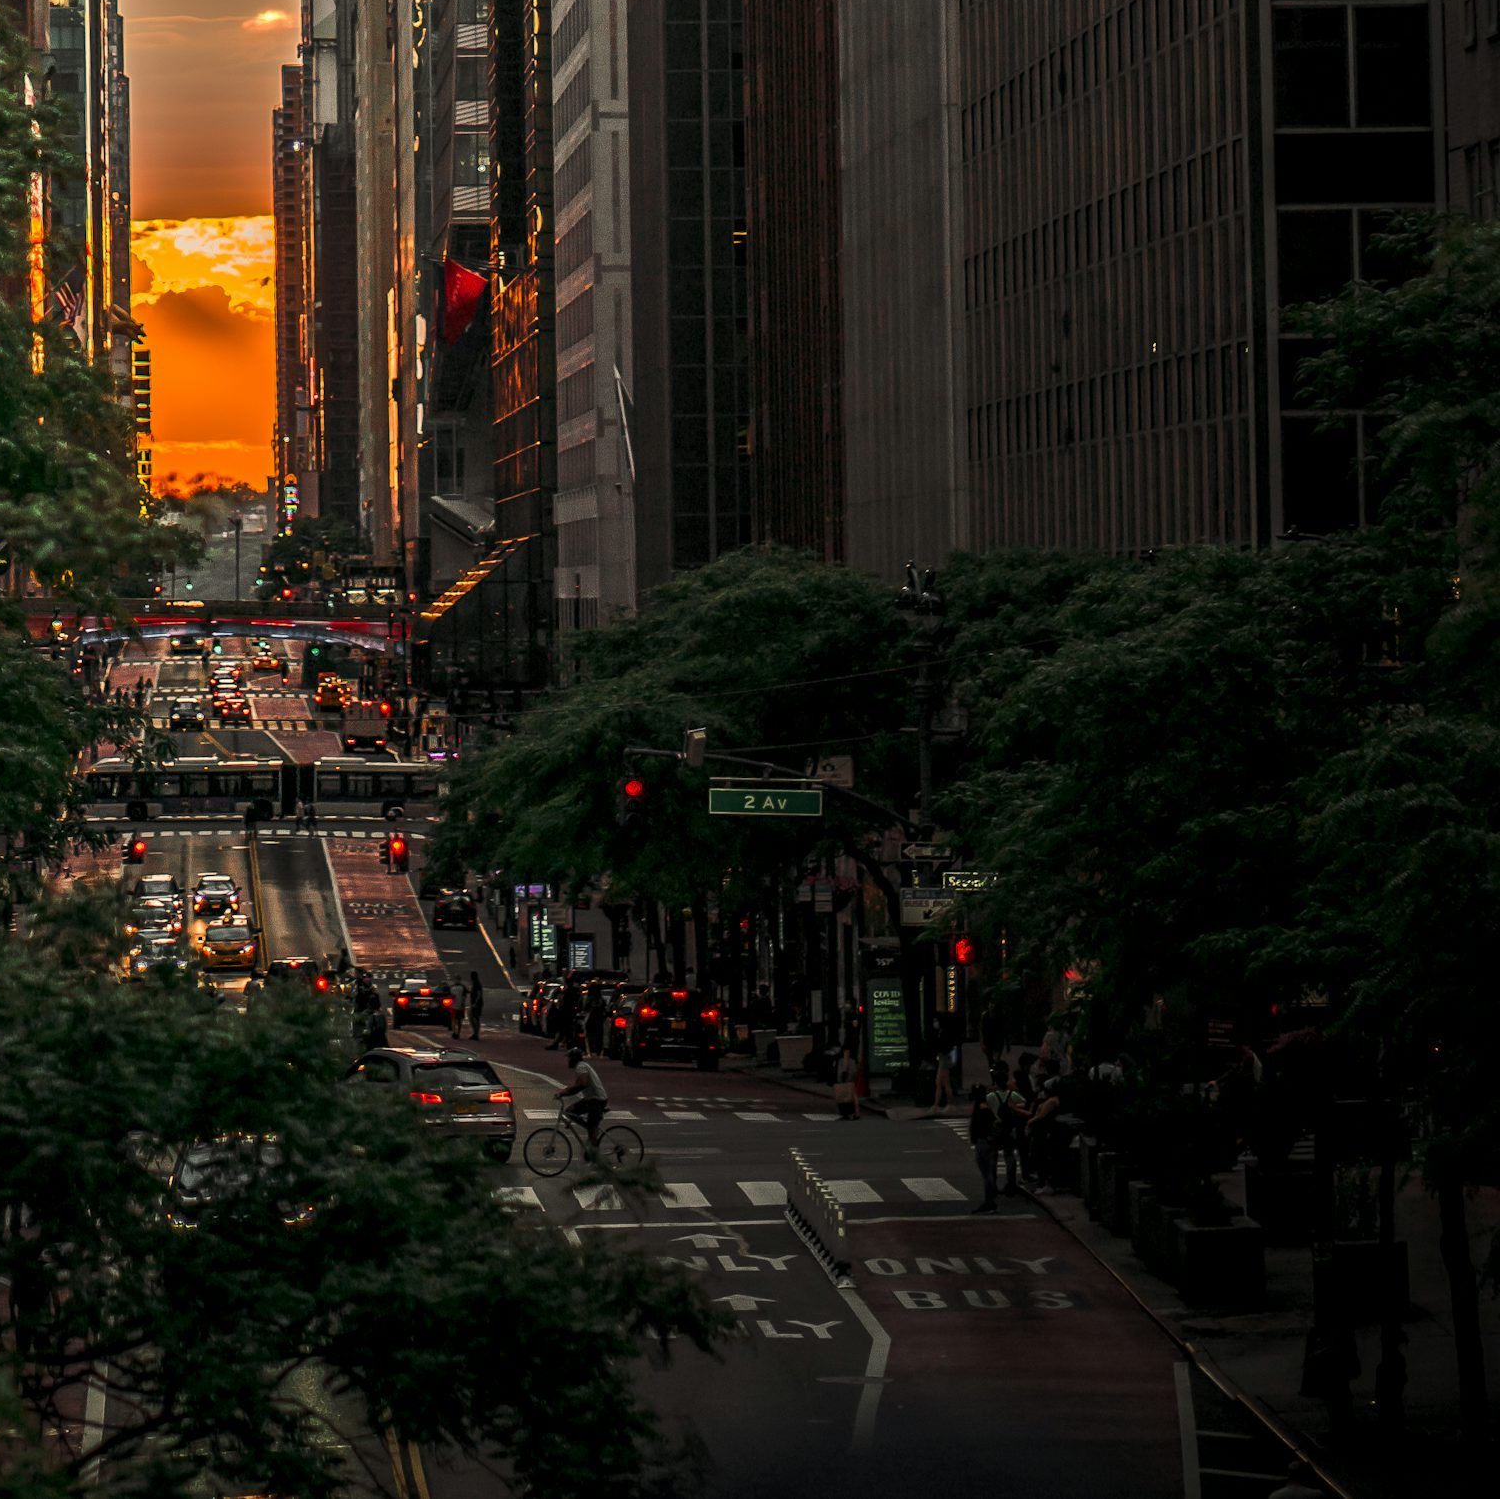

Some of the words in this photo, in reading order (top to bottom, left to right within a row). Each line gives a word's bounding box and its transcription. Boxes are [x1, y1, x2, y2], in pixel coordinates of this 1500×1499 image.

[744, 795, 756, 809] 2
[762, 795, 787, 810] Av
[873, 990, 901, 999] COVID
[654, 1254, 799, 1272] NLY
[863, 1257, 1055, 1276] ONLY
[891, 1289, 1075, 1310] BUS
